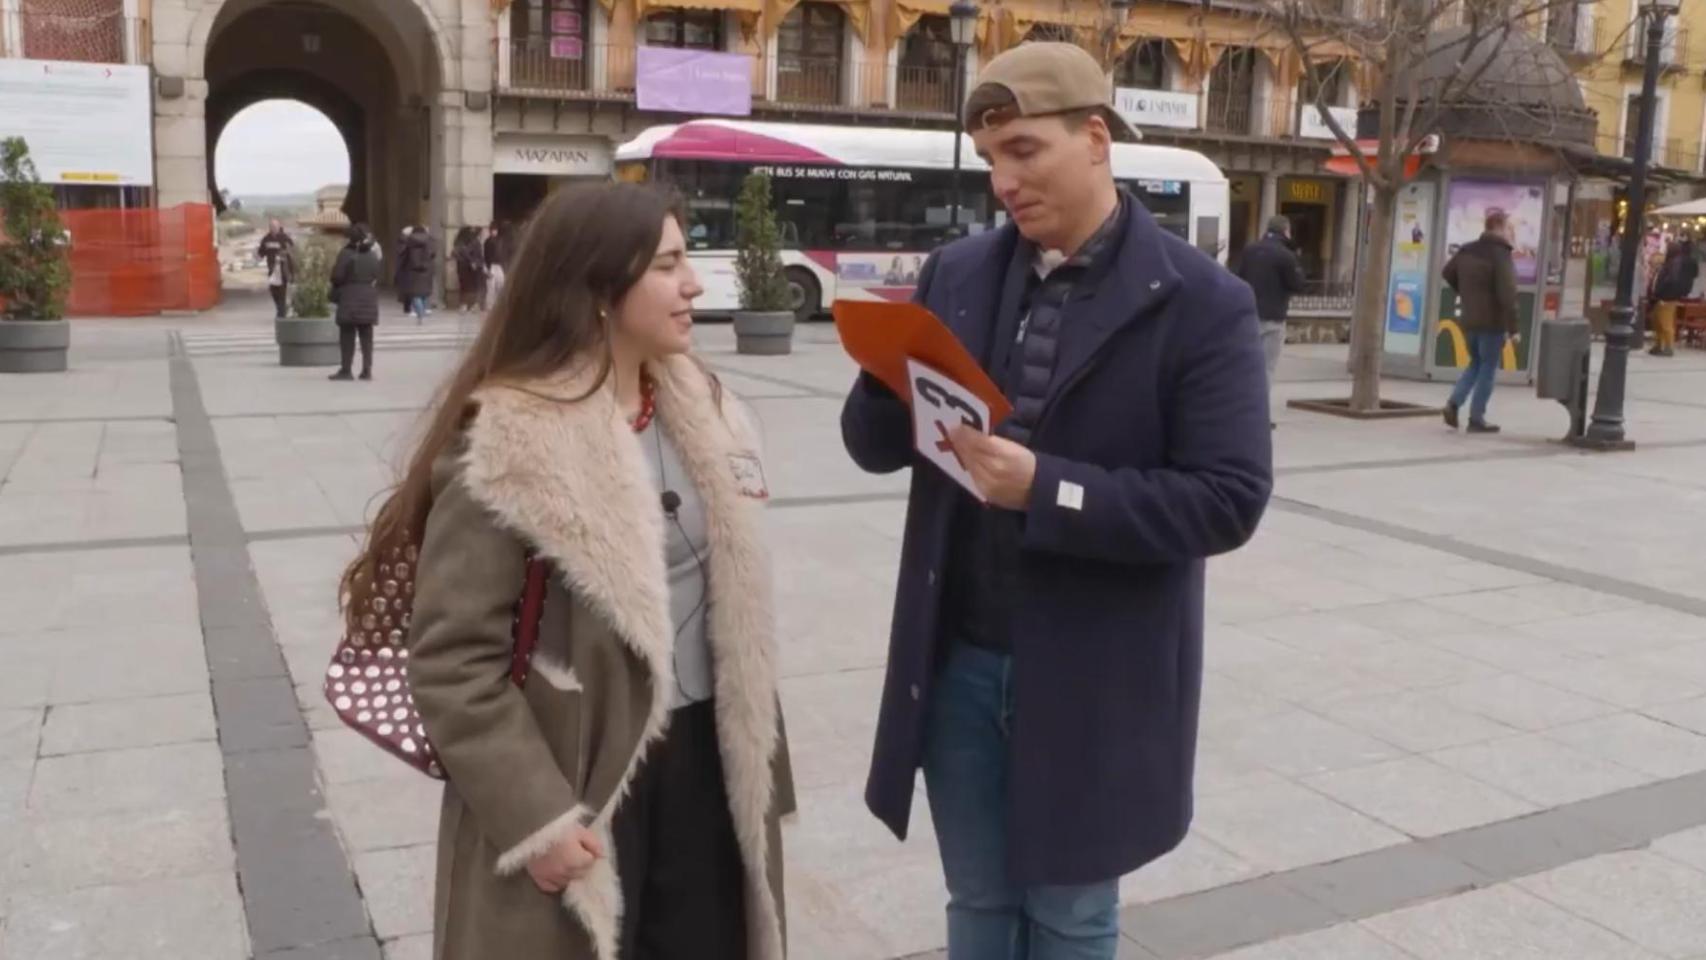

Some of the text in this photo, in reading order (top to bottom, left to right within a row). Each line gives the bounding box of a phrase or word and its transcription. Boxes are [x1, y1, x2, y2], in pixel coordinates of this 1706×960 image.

[514, 147, 589, 163] MAZAPAN
[776, 166, 793, 178] BUS
[794, 167, 806, 178] SE
[807, 167, 836, 180] MUEVE
[837, 168, 857, 180] CON
[858, 169, 876, 181] GAS
[877, 170, 913, 182] NATURAL
